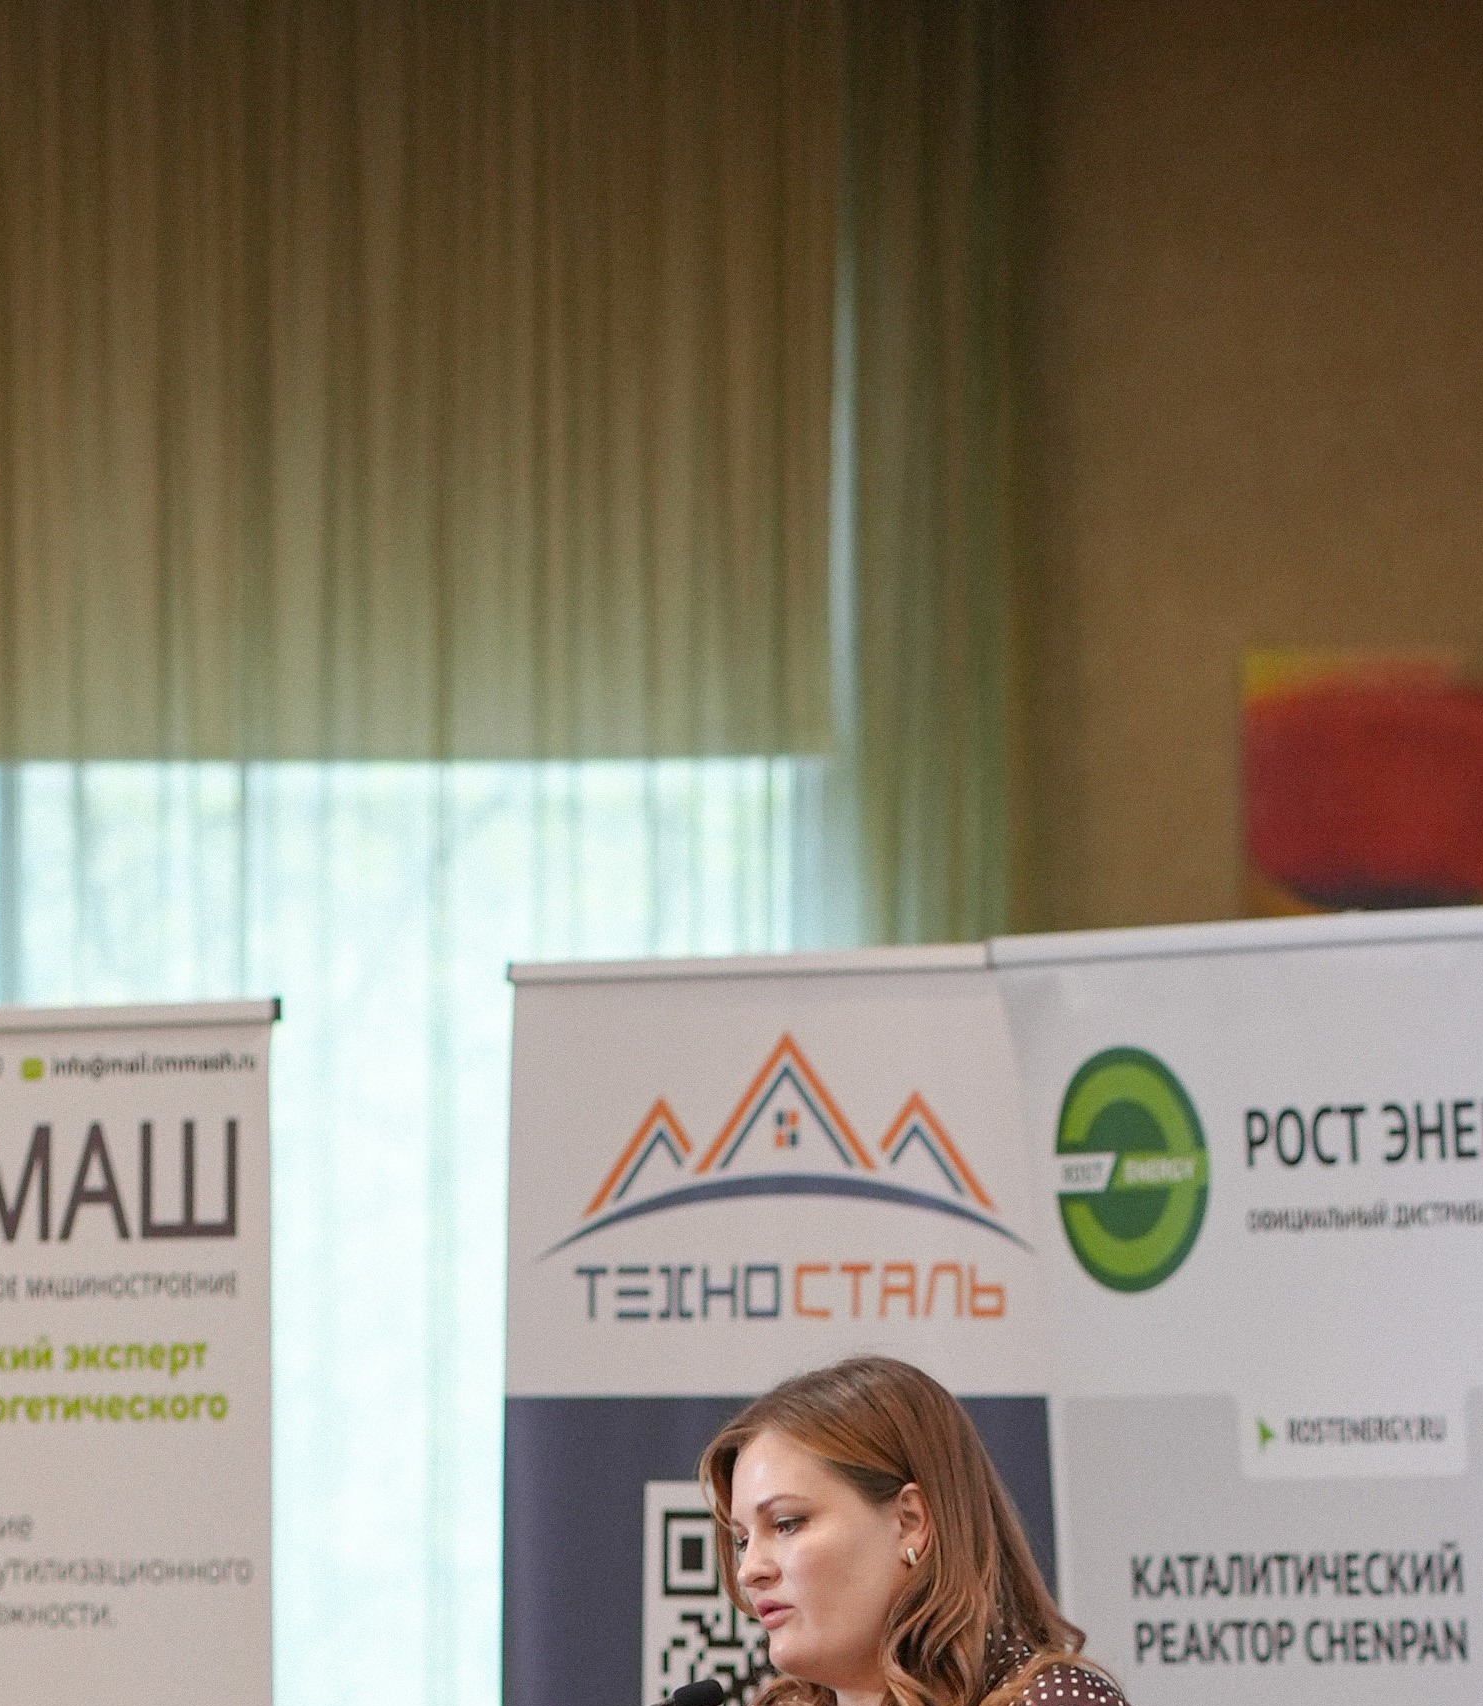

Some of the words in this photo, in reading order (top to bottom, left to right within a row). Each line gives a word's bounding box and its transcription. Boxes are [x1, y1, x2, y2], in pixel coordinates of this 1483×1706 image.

[1246, 1103, 1366, 1170] РОСТ
[574, 1262, 1007, 1322] ТЕХНОСТАЛЬ
[65, 1340, 206, 1378] эксперт
[1131, 1541, 1464, 1598] КАТАЛИТИЧЕСКИЙ
[1135, 1620, 1295, 1667] РЕАКТОР
[1306, 1618, 1469, 1665] CHENPAN
